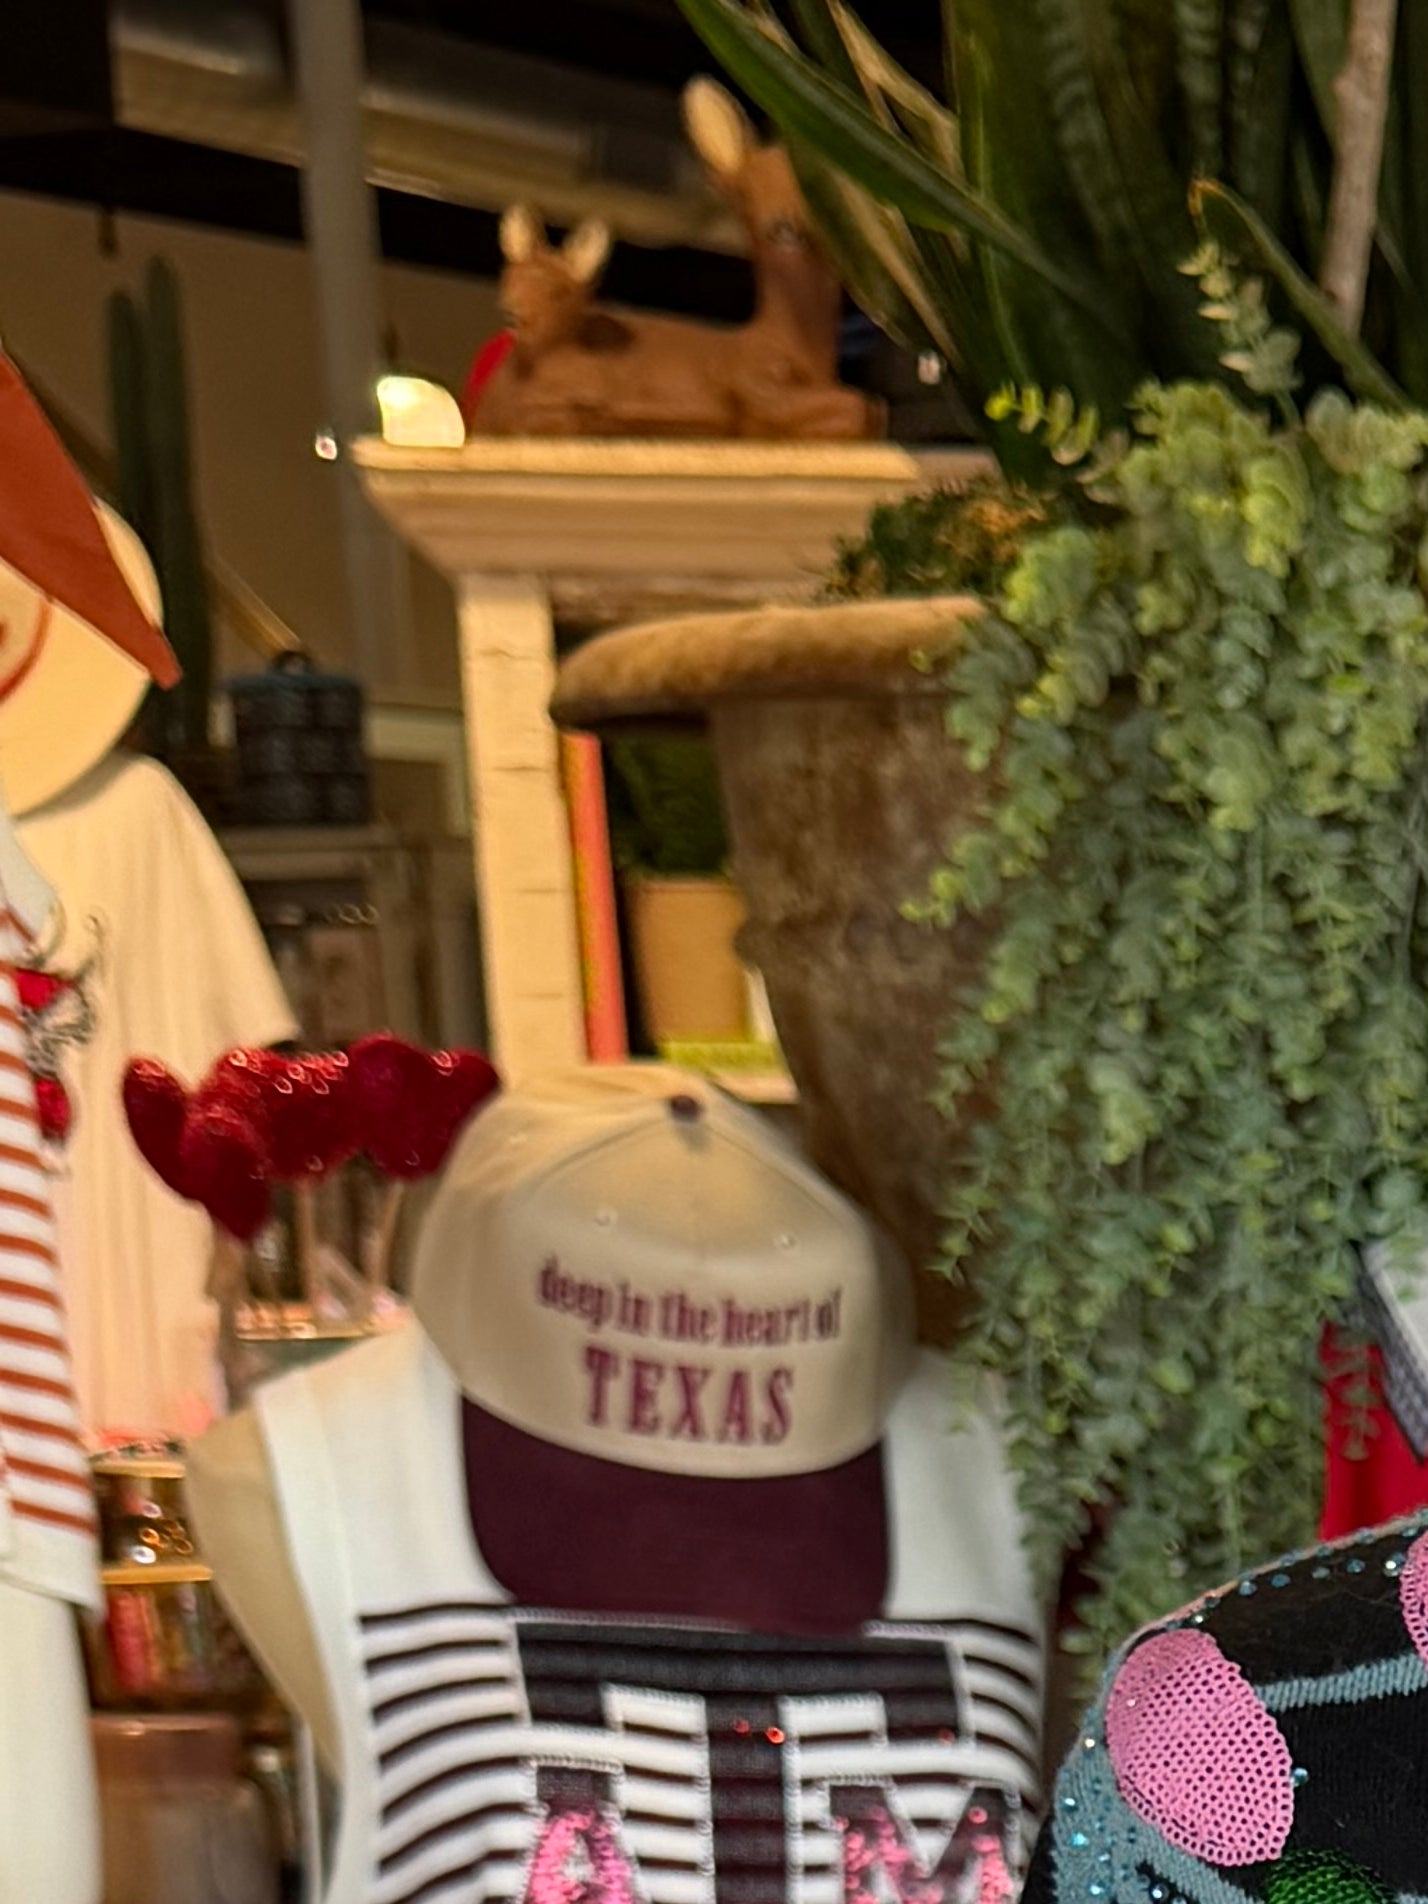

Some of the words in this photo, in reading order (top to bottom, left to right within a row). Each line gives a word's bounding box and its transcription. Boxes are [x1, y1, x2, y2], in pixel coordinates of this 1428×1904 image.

[538, 1254, 609, 1334] deep
[616, 1275, 650, 1336] in
[656, 1289, 715, 1344] the
[720, 1292, 812, 1347] heart
[815, 1283, 843, 1342] of
[582, 1344, 797, 1447] TEXAS
